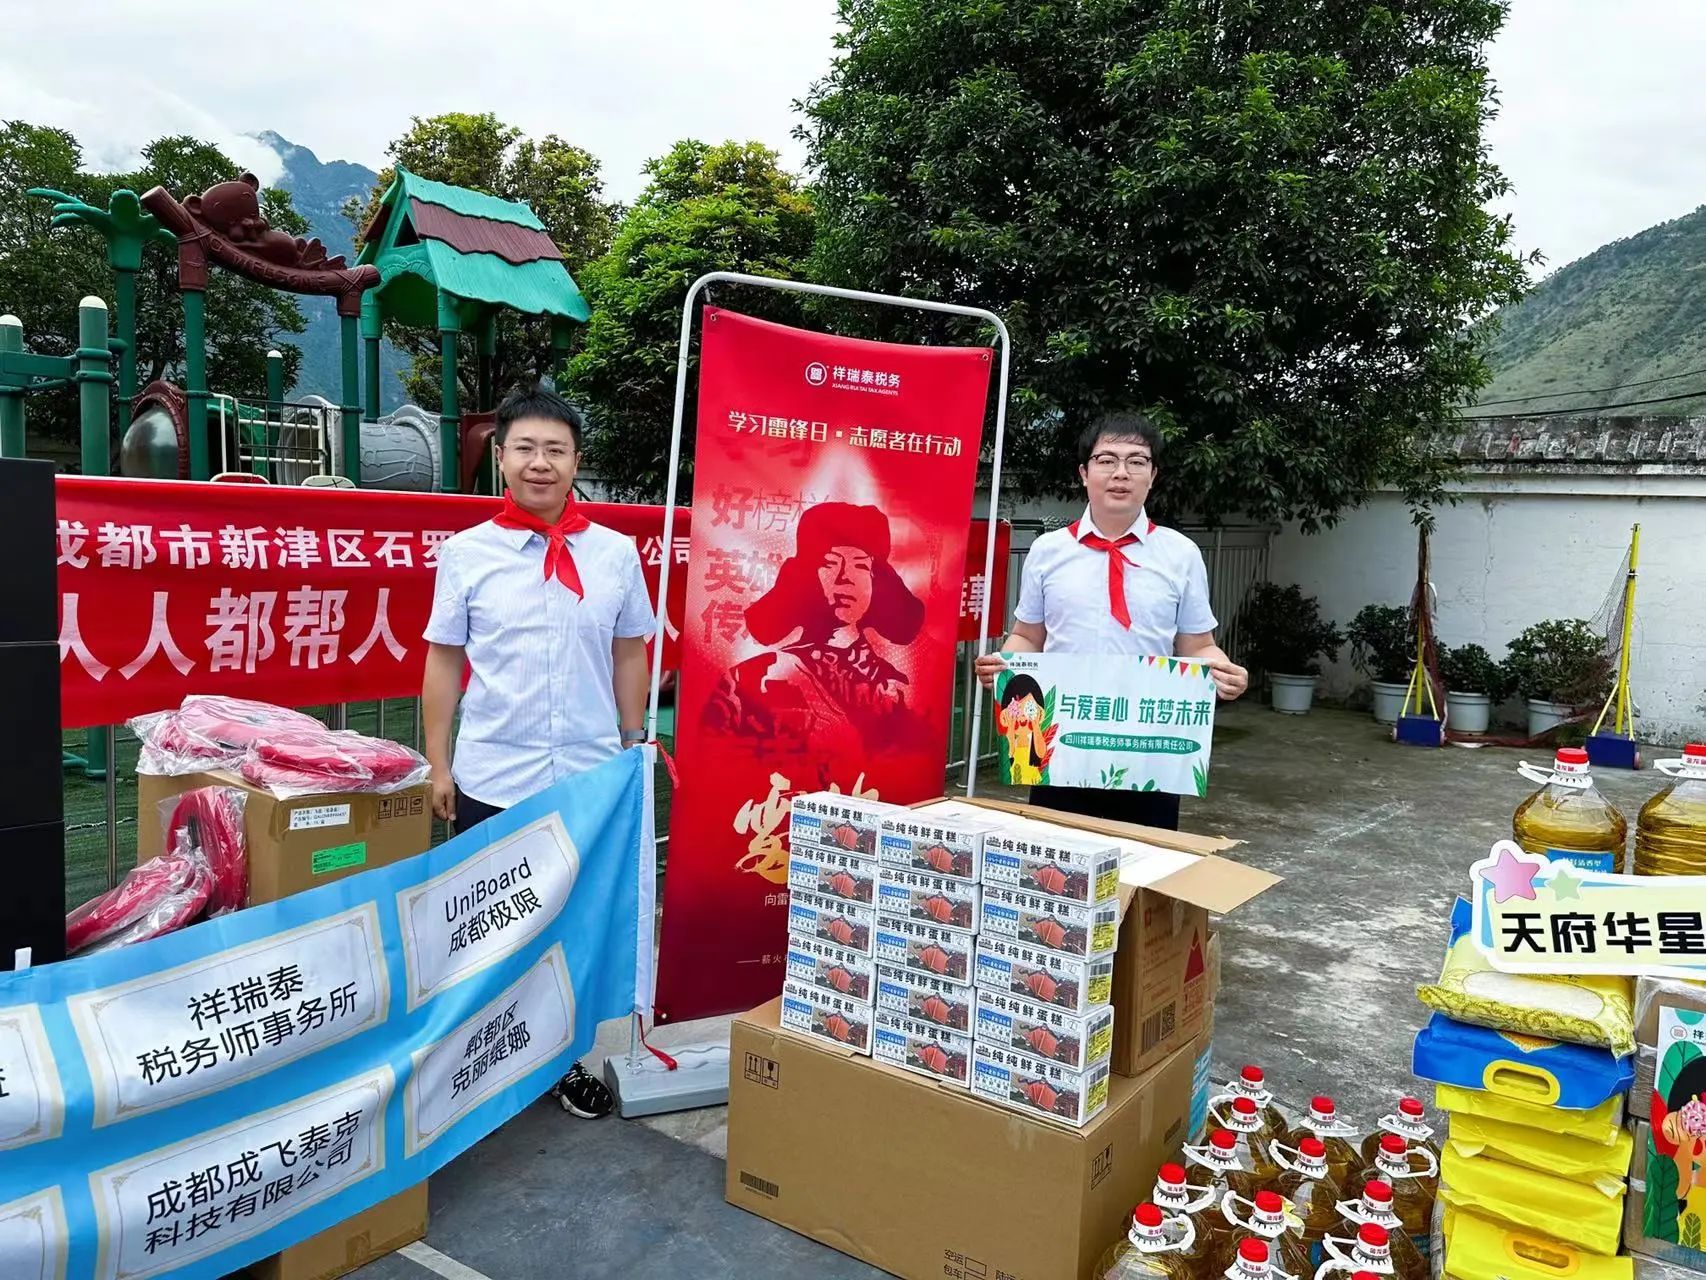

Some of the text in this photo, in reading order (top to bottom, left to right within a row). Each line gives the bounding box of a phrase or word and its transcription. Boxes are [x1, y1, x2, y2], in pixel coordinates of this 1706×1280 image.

[832, 365, 900, 388] 祥瑞泰税务
[58, 584, 408, 682] 人人都帮人
[1059, 694, 1212, 726] 与爱童心 筑梦未来
[1065, 734, 1194, 751] 四川祥瑞泰税务师事务所有限责任公司
[807, 802, 862, 821] 纯纯鲜蛋糕
[896, 822, 957, 843] 纯纯鲜蛋糕
[804, 849, 860, 870] 纯纯鲜蛋糕
[1002, 838, 1071, 863] 纯纯鲜蛋糕
[445, 856, 532, 923] UniBoard
[894, 872, 956, 893] 纯纯鲜蛋糕
[1001, 890, 1070, 917] 纯纯鲜蛋糕
[448, 887, 542, 958] 成都极限
[1501, 911, 1706, 954] 天府华星
[802, 940, 856, 965] 纯纯鲜蛋糕
[994, 942, 1063, 970] 纯纯鲜蛋糕
[187, 964, 304, 1031] 祥瑞泰
[798, 987, 854, 1013] 纯纯鲜蛋糕
[994, 996, 1063, 1027] 纯纯鲜蛋糕
[136, 981, 358, 1086] 税务师事务所
[464, 1000, 519, 1059] 郫都区
[891, 1017, 951, 1043] 纯纯鲜蛋糕
[451, 1021, 531, 1100] 克丽缇娜
[992, 1049, 1063, 1080] 纯纯鲜蛋糕
[146, 1109, 363, 1225] 成都成飞泰克
[144, 1138, 353, 1254] 科技有限公司
